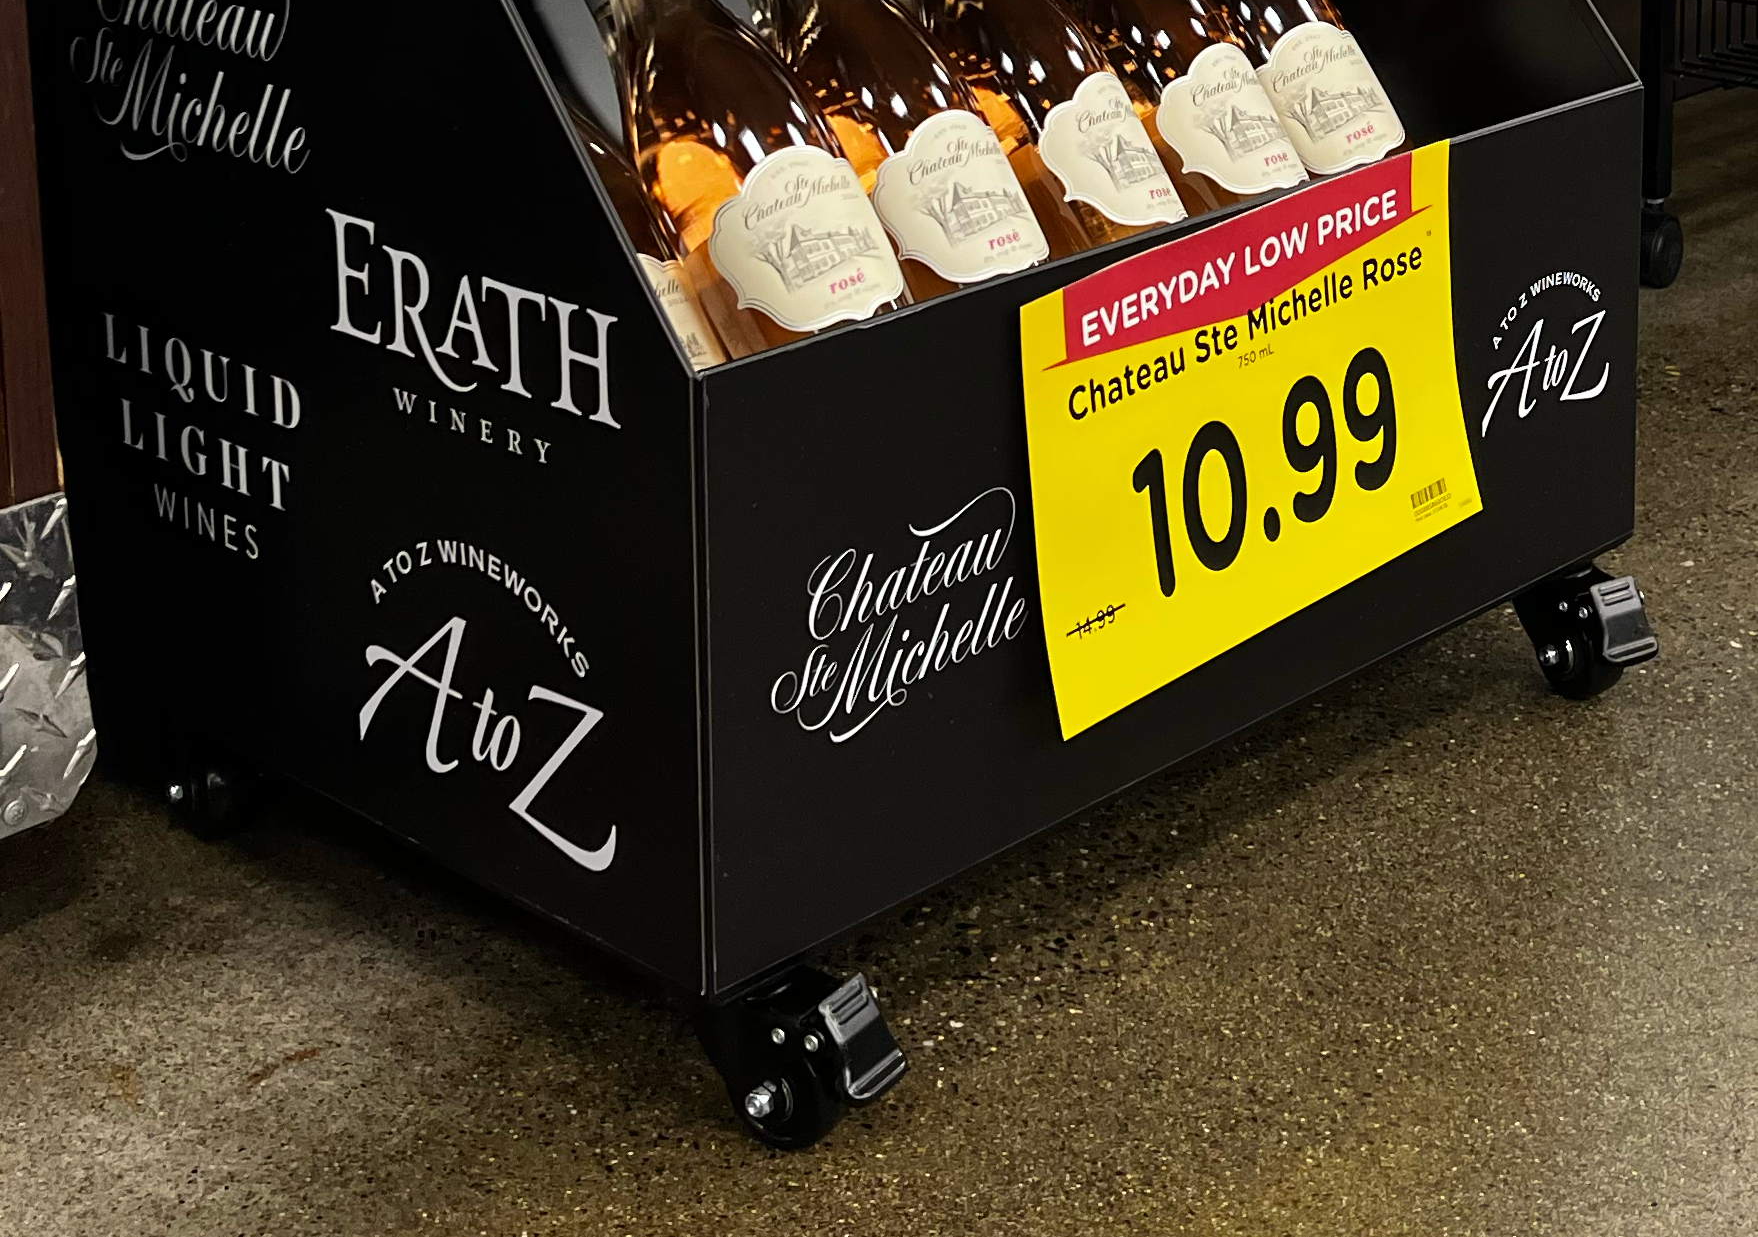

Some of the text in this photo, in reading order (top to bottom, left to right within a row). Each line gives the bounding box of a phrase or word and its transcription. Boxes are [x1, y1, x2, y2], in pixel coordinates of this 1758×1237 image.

[70, 26, 311, 174] Ste Michelle
[1190, 79, 1238, 107] Chateau
[1271, 60, 1319, 93] Chateau
[1303, 44, 1323, 63] Ste
[907, 153, 963, 186] Chateau
[946, 135, 969, 155] Ste
[1076, 109, 1122, 134] Chateau
[1345, 120, 1375, 144] rosé
[742, 193, 803, 231] Chateau
[784, 173, 810, 194] Ste
[988, 227, 1021, 251] rosé
[828, 267, 867, 295] rosé
[1081, 188, 1398, 347] EVERYDAY LOW PRICE
[325, 207, 622, 430] ERATH
[1068, 245, 1423, 421] Chateau Ste Michelle Rose
[1492, 271, 1602, 350] A TO Z WINEWORKS
[102, 311, 301, 429] LIQUID
[1237, 343, 1275, 370] 750 mL
[120, 396, 290, 511] LIGHT
[392, 386, 552, 464] WINERY
[1132, 347, 1397, 597] 10.99
[153, 482, 259, 560] WINES
[807, 486, 1016, 640] Chateau
[370, 539, 590, 678] A TO Z WINEWORKS
[1075, 604, 1117, 640] 14.99
[771, 576, 1029, 743] Ste Michelle
